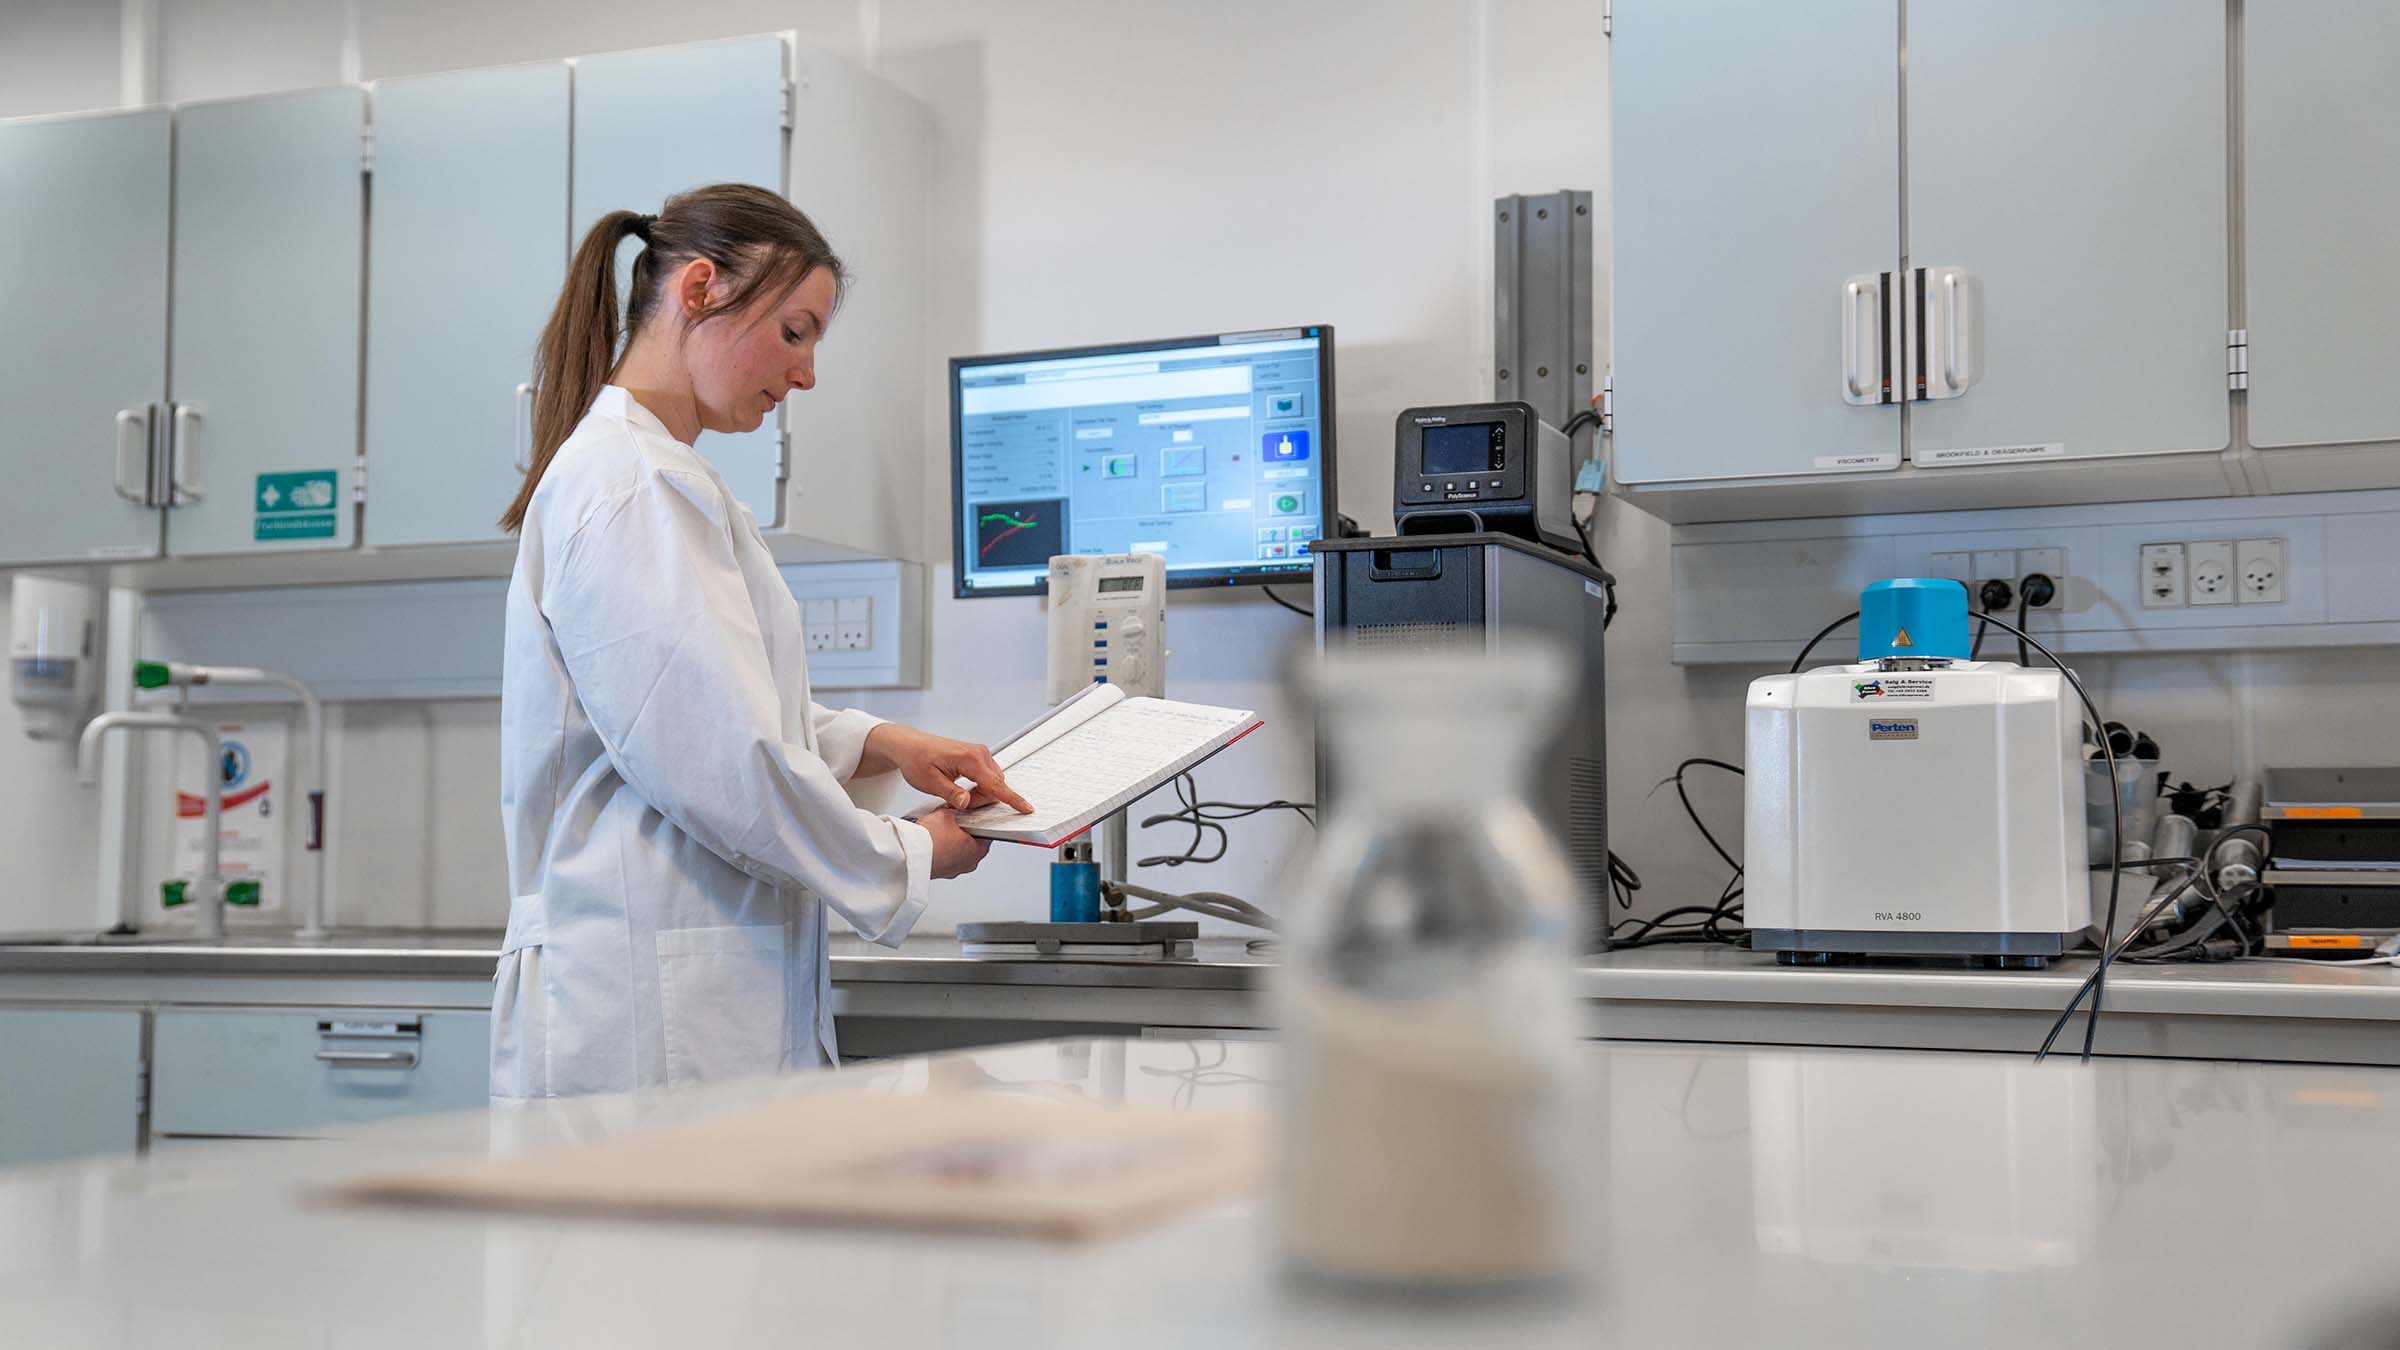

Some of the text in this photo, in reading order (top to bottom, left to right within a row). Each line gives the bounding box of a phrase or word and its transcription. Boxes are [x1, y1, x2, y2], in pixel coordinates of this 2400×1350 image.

[1936, 449, 1980, 458] BROOKFIELD
[1837, 456, 1880, 465] VISCOMETRY
[1872, 723, 1915, 732] Perten
[1874, 912, 1921, 921] RVA 4800
